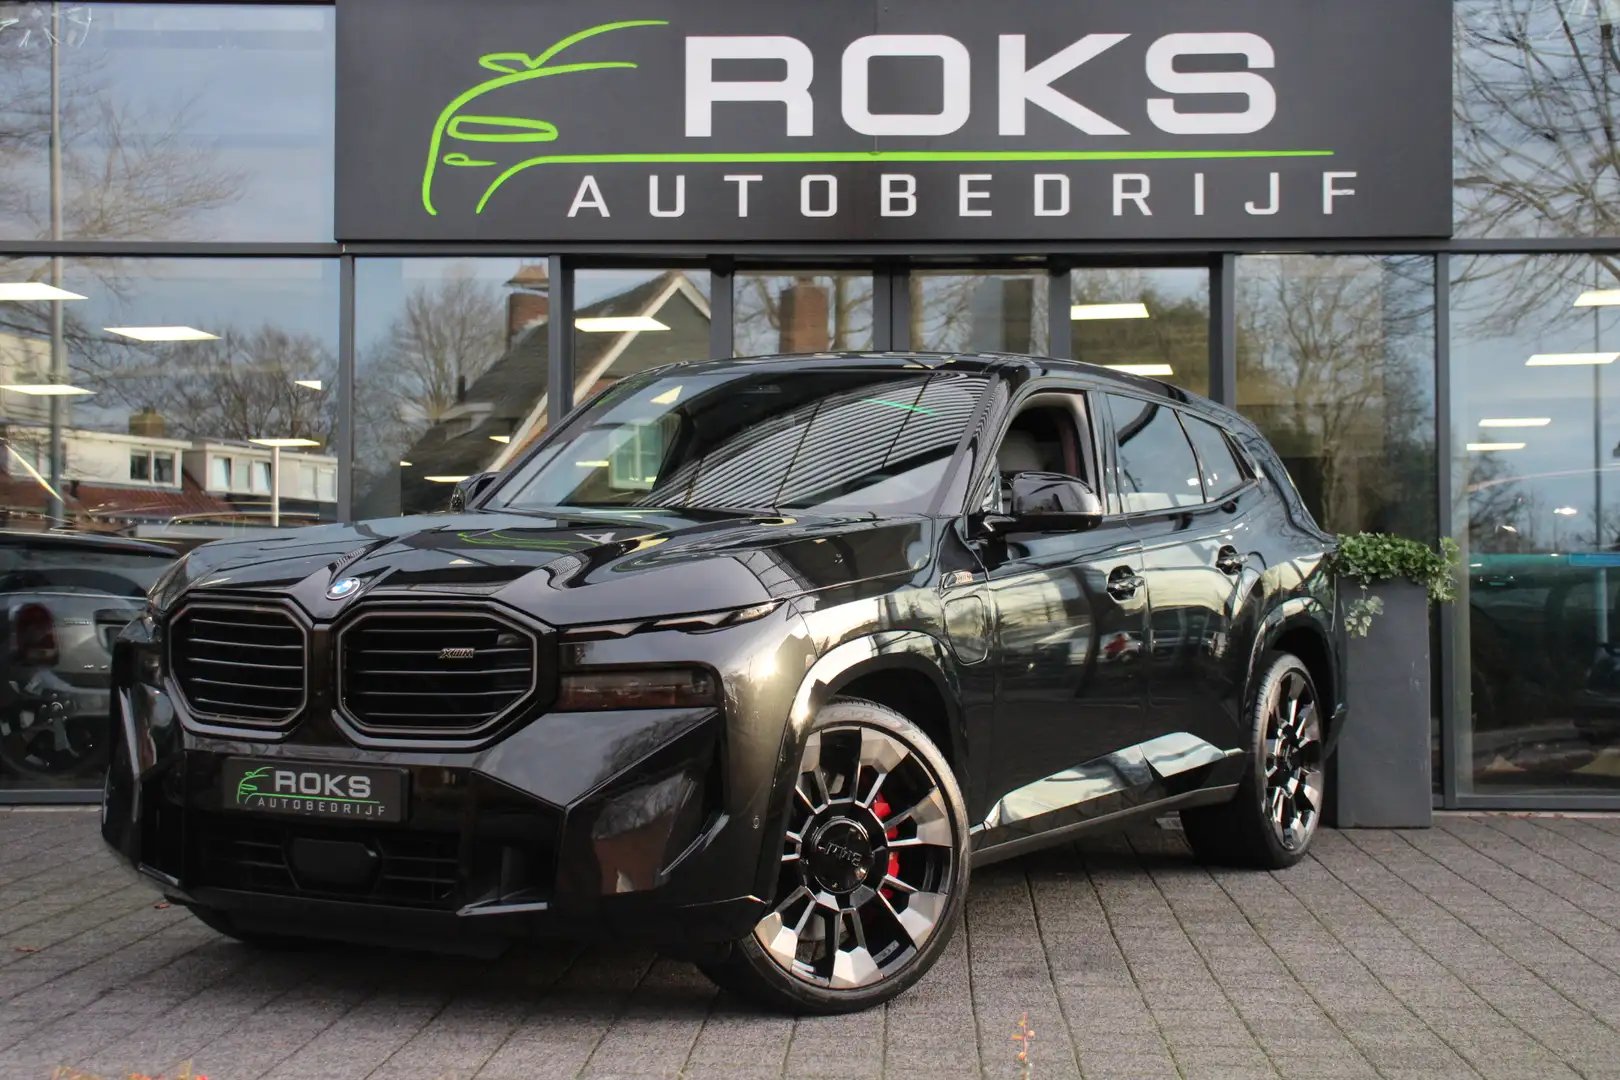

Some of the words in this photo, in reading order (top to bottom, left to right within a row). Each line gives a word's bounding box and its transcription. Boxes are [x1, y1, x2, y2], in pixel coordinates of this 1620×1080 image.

[684, 32, 1277, 138] ROKS
[567, 171, 1357, 218] AUTOBEDRIJF
[275, 770, 371, 798] ROKS
[257, 797, 386, 816] AUTOBEDRIJF
